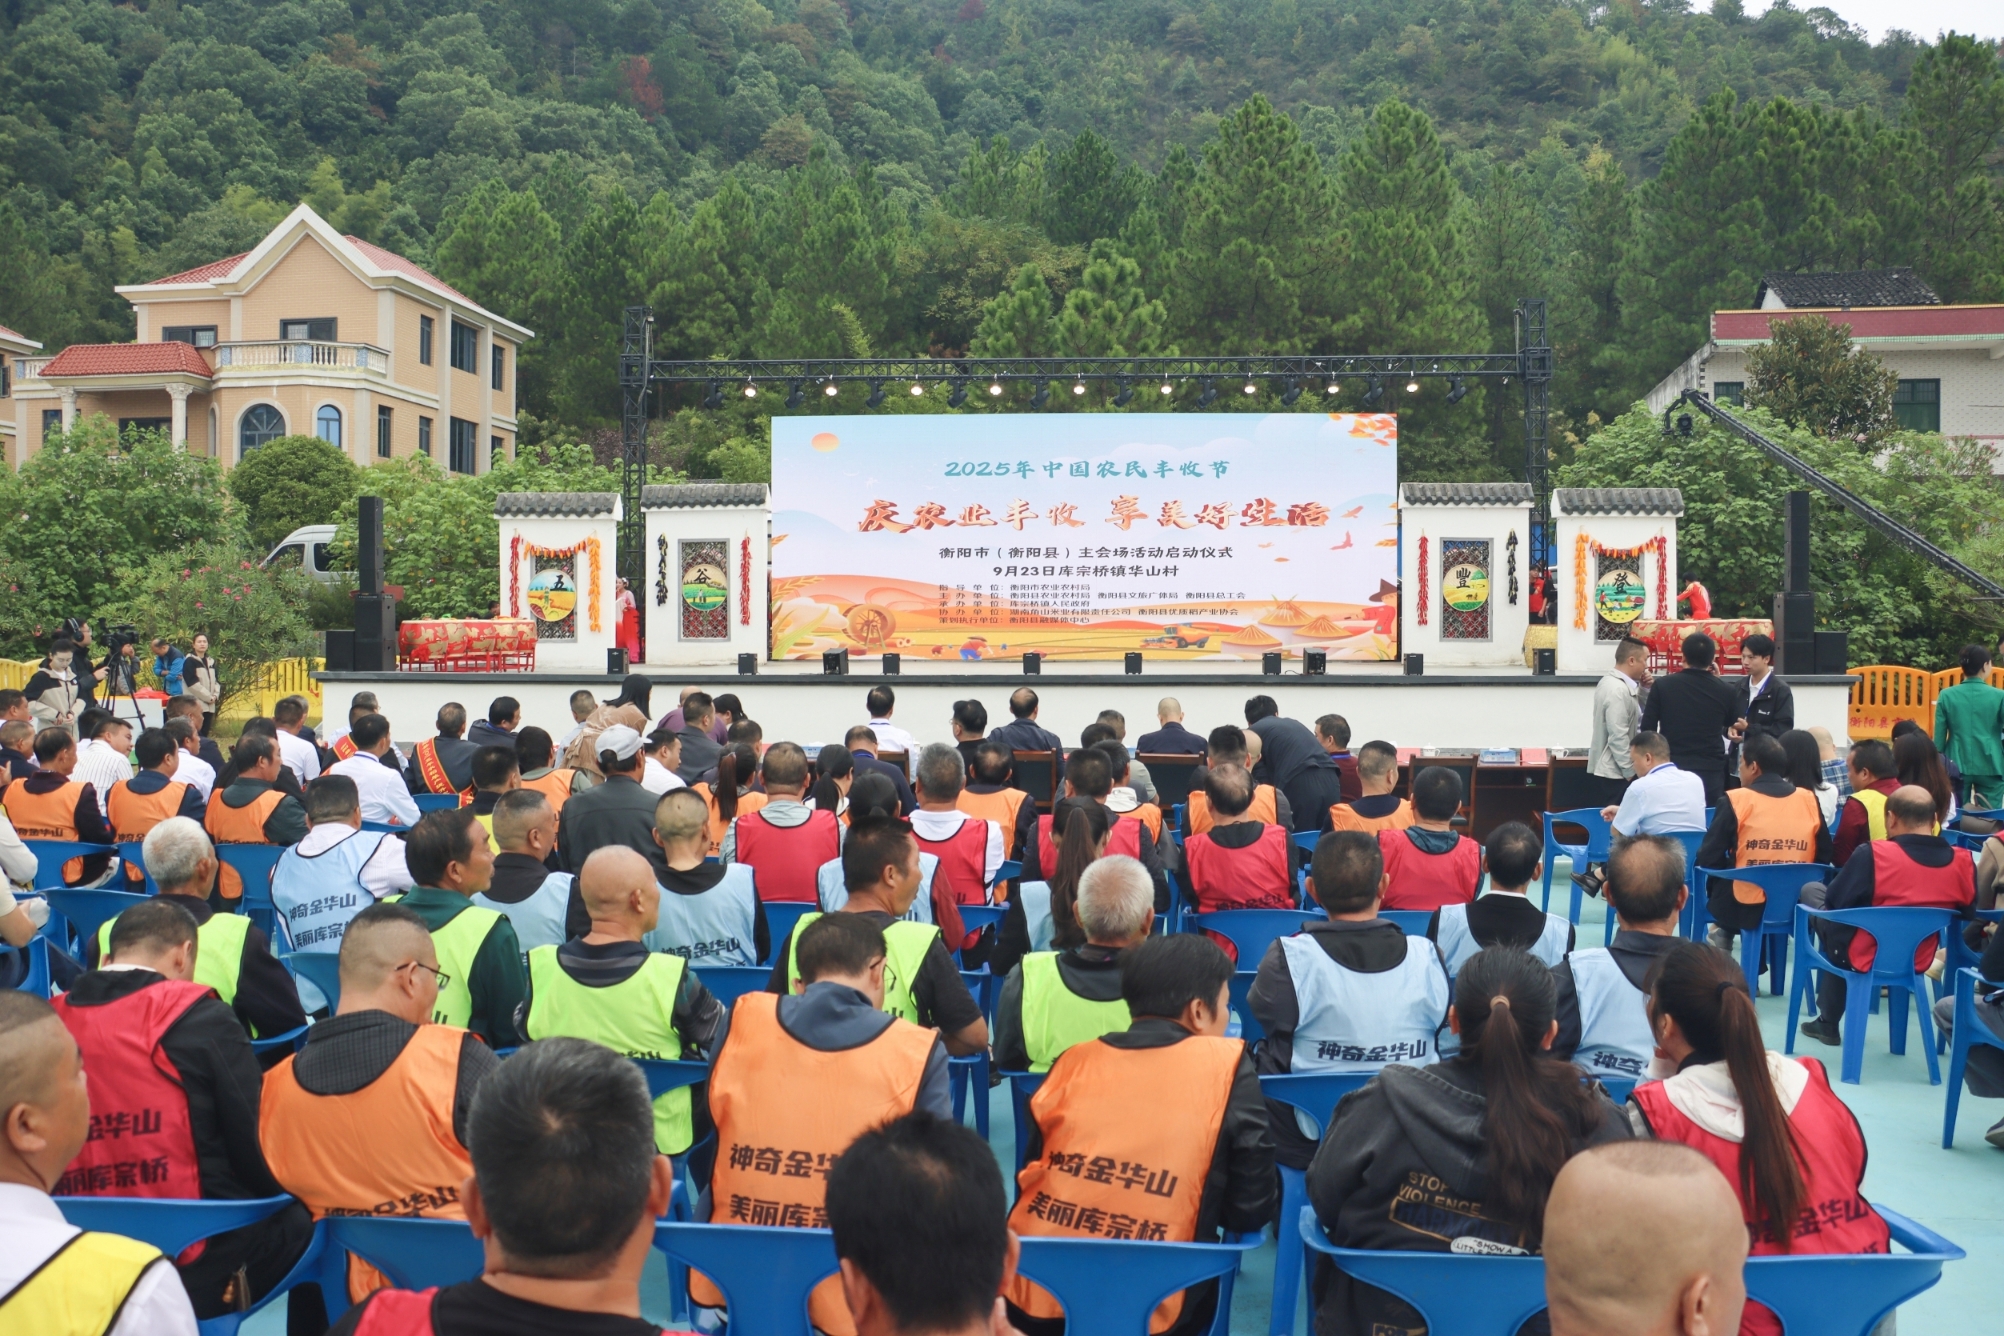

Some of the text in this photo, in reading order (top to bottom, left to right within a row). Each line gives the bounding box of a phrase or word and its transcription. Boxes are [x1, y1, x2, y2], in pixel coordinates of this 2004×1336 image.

[944, 460, 1230, 479] 2025年中国农民丰收节
[857, 494, 1331, 533] 庆农业丰收 享美好生活
[693, 568, 711, 584] 谷
[993, 565, 1179, 578] 9月23日库宗桥镇华山村
[551, 574, 568, 592] 五
[1745, 838, 1808, 851] 神奇金华山
[289, 893, 357, 922] 神奇金华山
[294, 921, 350, 949] 美丽库宗
[1317, 1039, 1427, 1062] 神奇金华山
[1047, 1150, 1178, 1198] 神奇金华山
